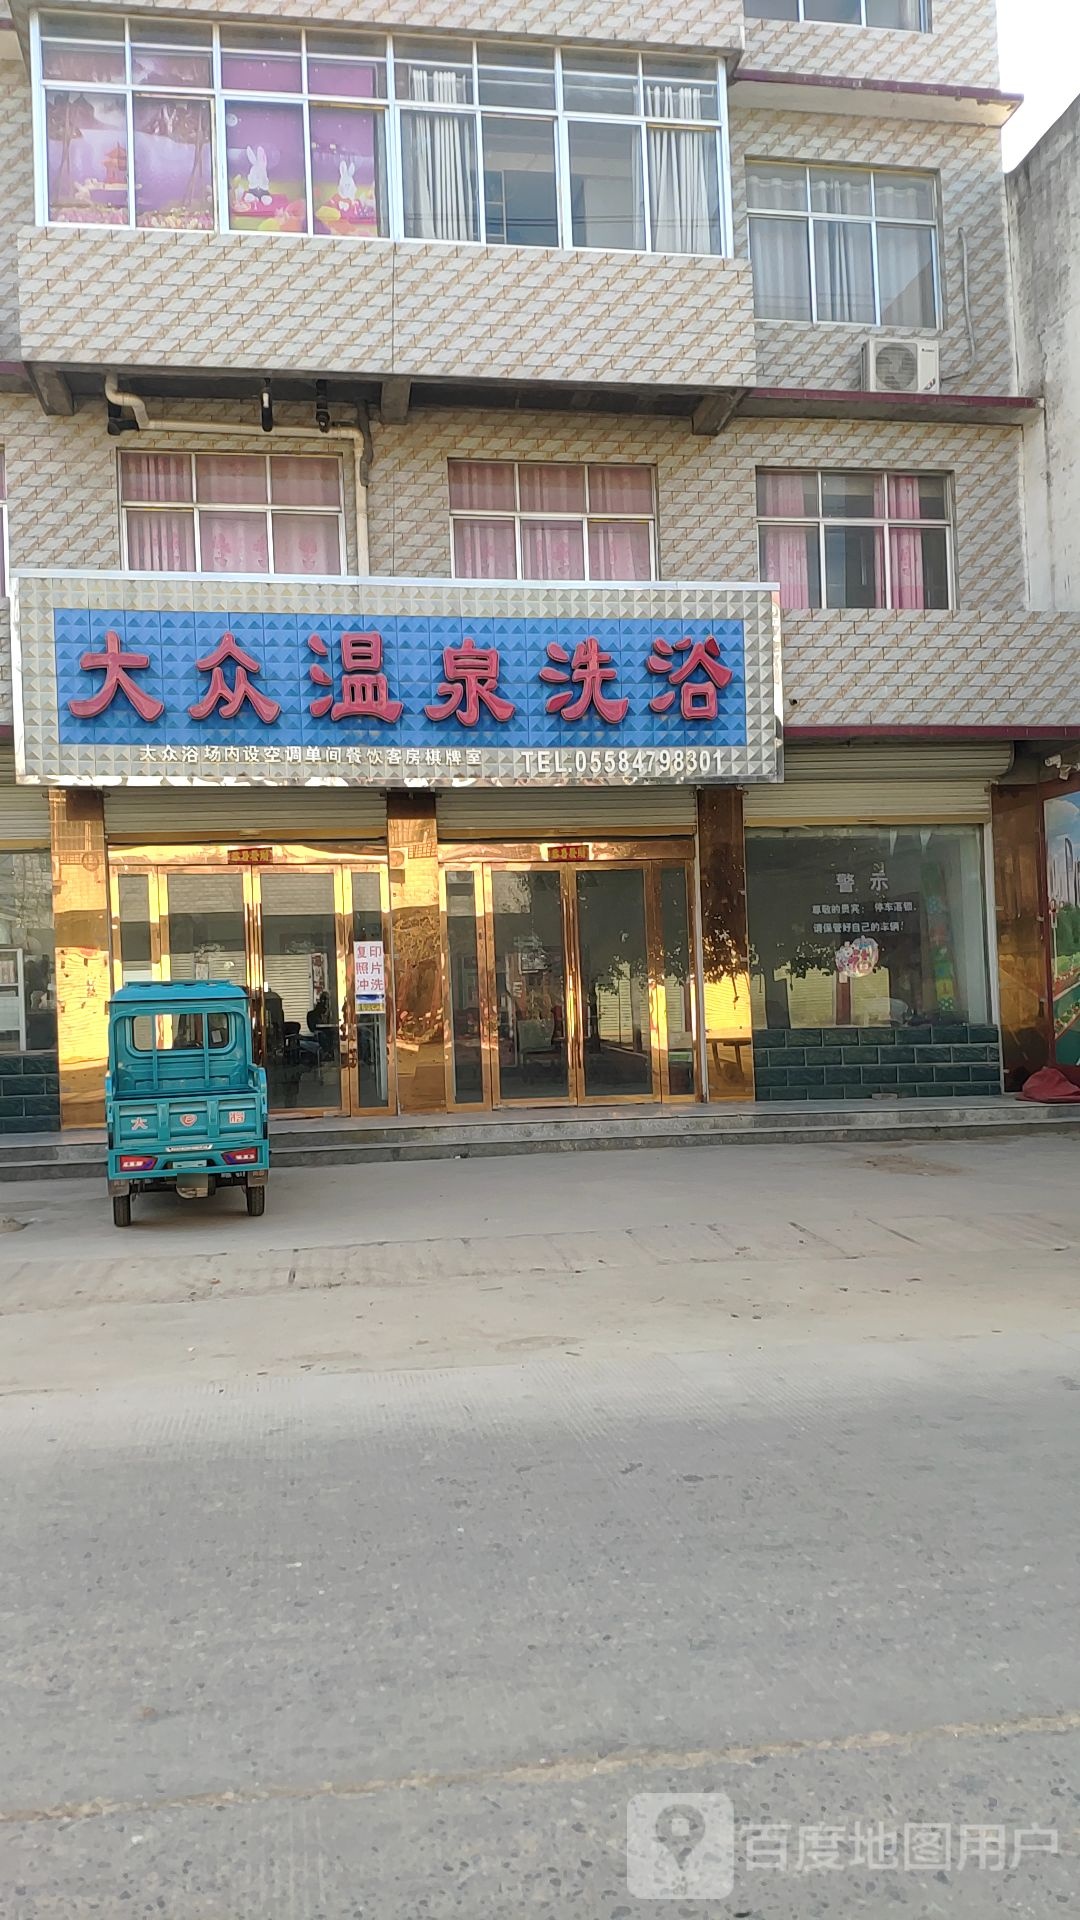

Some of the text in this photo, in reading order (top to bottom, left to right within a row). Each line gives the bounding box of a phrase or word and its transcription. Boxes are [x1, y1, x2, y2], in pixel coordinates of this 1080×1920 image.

[68, 630, 733, 727] 大众温泉洗浴
[139, 744, 484, 767] 大众浴场内设空调单间餐饮客房棋牌室
[520, 749, 722, 774] TEL.05584798301
[835, 872, 889, 893] 警示
[357, 945, 382, 959] 复印
[355, 961, 382, 975] 照片
[356, 978, 384, 991] 冲洗
